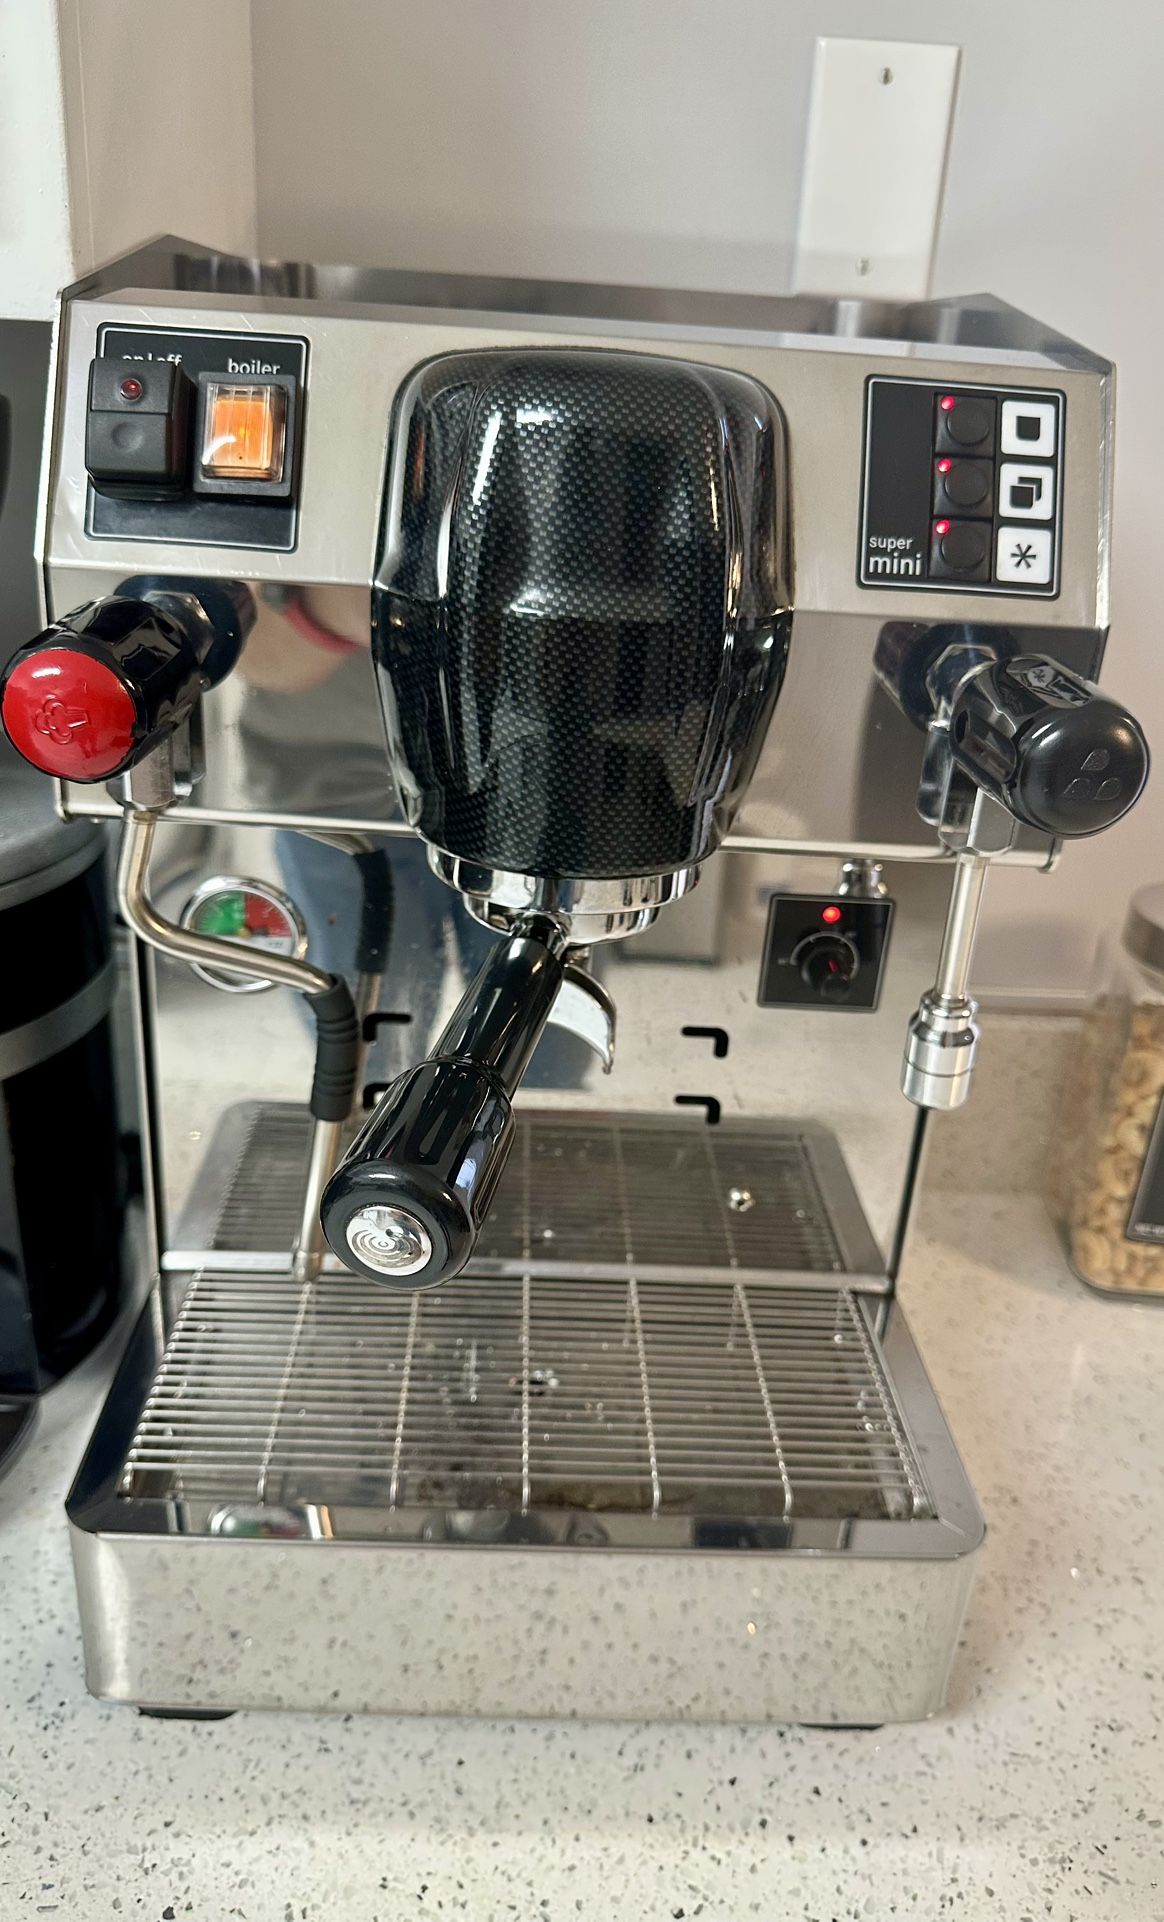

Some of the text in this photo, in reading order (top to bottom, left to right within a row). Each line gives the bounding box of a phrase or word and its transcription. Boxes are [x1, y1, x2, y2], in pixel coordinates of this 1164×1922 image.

[228, 358, 280, 374] boiler
[869, 537, 913, 552] super
[869, 552, 921, 576] mini
